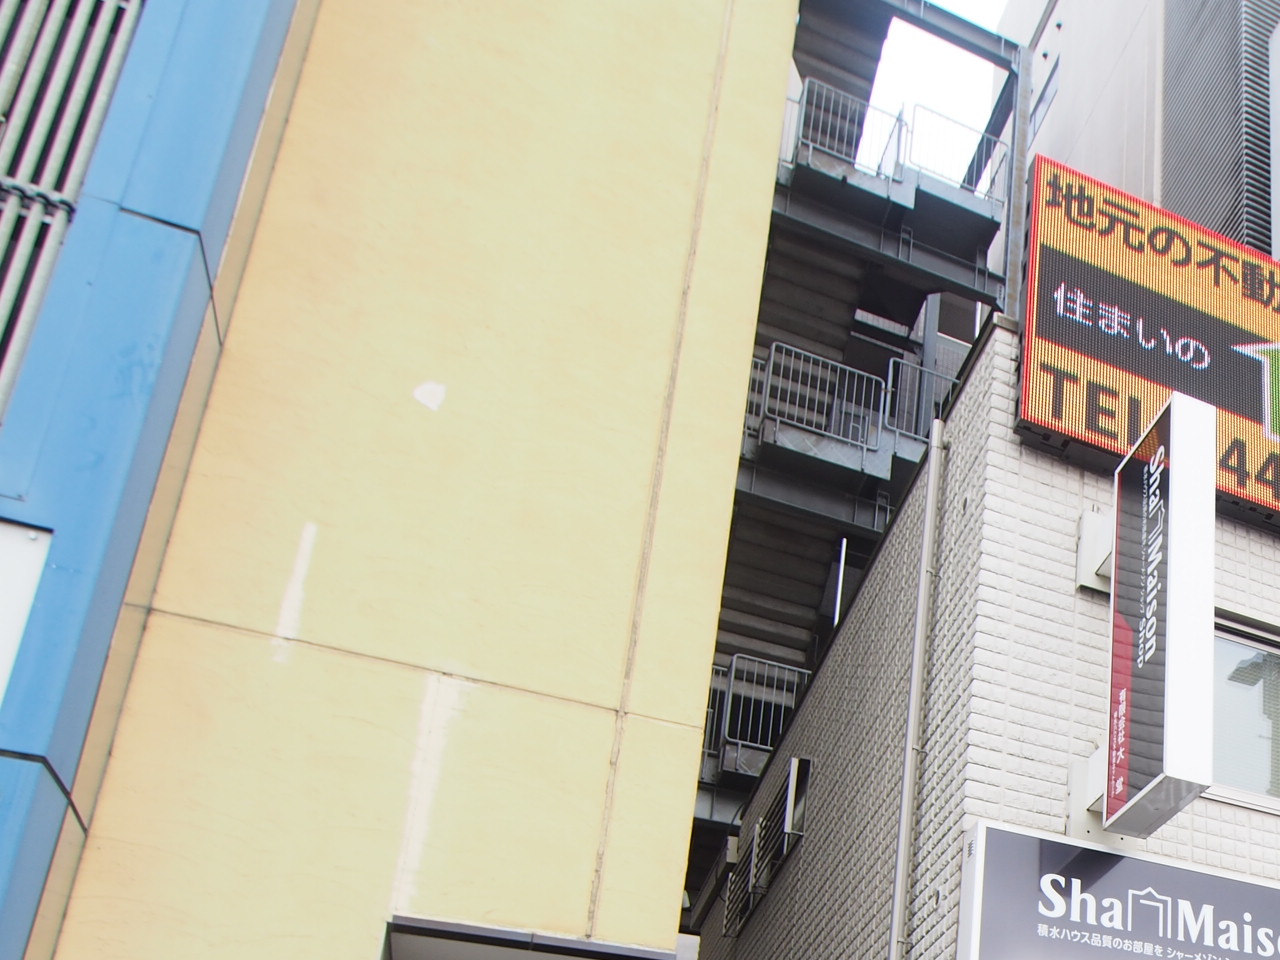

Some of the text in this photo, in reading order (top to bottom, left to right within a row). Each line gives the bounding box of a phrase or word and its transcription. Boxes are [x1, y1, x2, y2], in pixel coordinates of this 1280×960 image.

[1054, 281, 1211, 370] 住まいの
[1145, 533, 1164, 662] Maison
[1037, 923, 1163, 957] 積水ハウス品質のお部屋を
